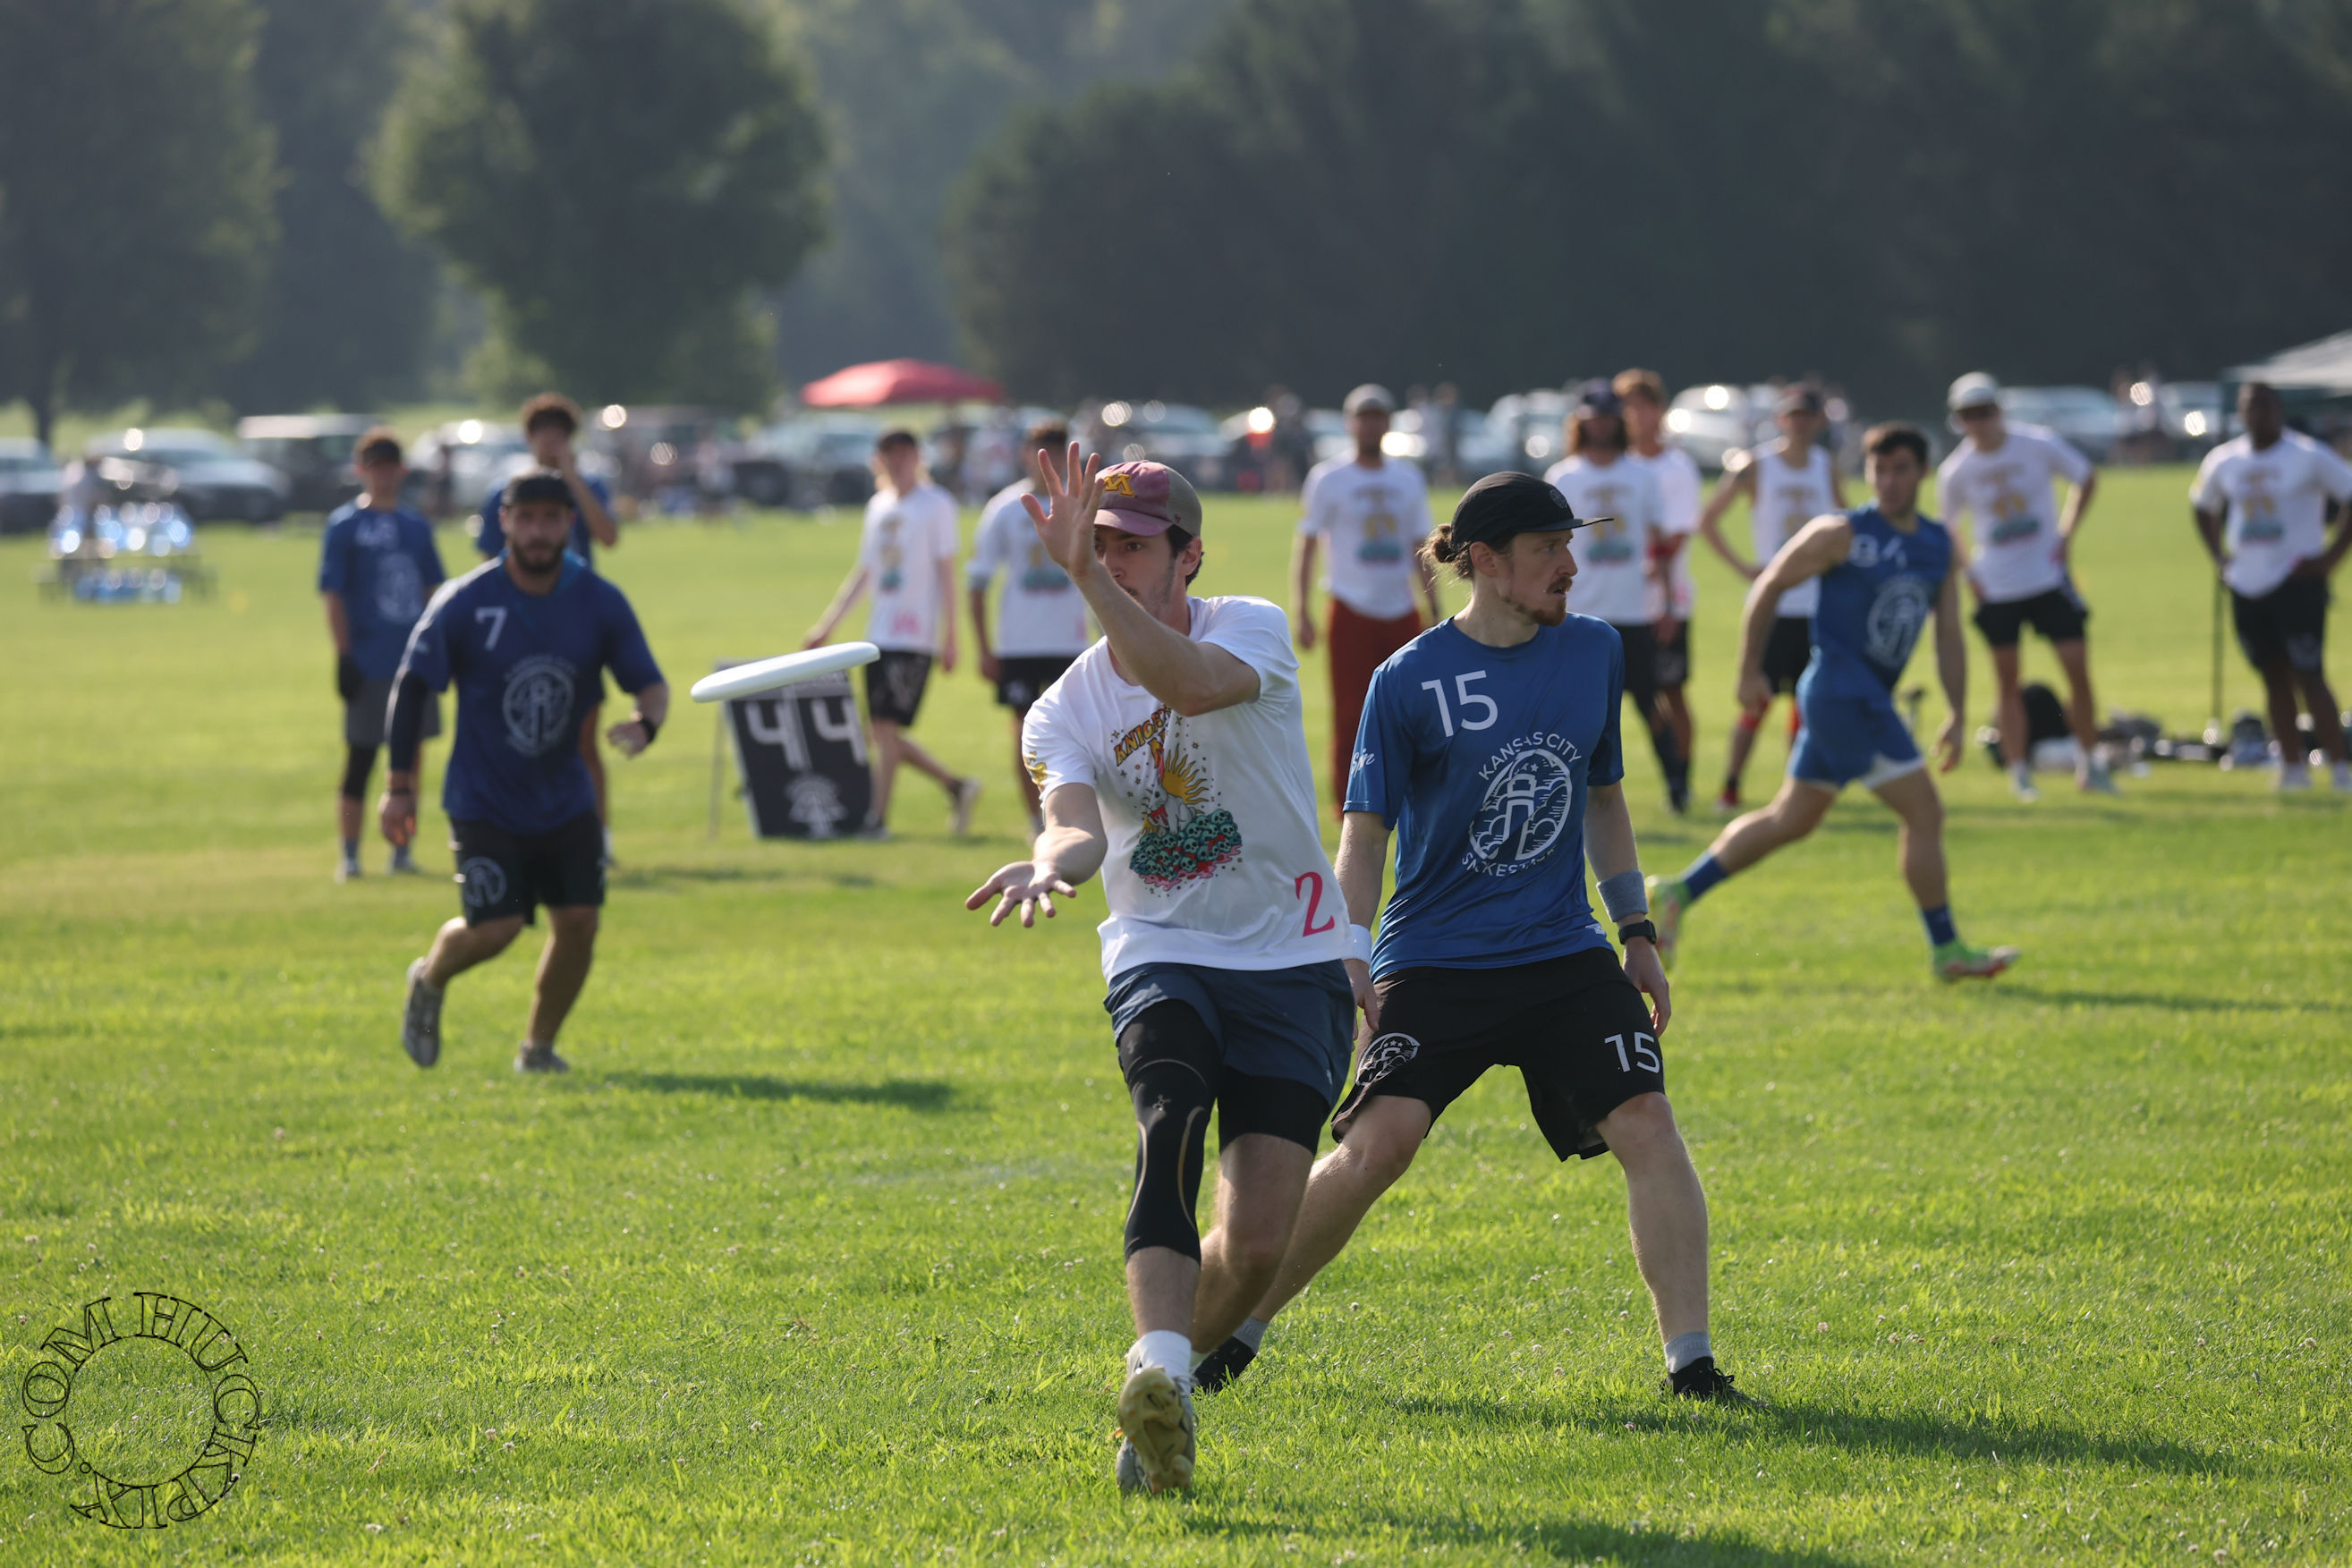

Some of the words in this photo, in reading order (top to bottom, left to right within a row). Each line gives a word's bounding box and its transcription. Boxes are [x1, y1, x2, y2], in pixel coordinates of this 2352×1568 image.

[475, 606, 507, 650] 7
[1421, 670, 1499, 737] 15
[1478, 732, 1543, 781] KANSAS
[1546, 733, 1582, 763] CITY
[1295, 871, 1336, 937] 2
[1604, 1031, 1660, 1074] 15
